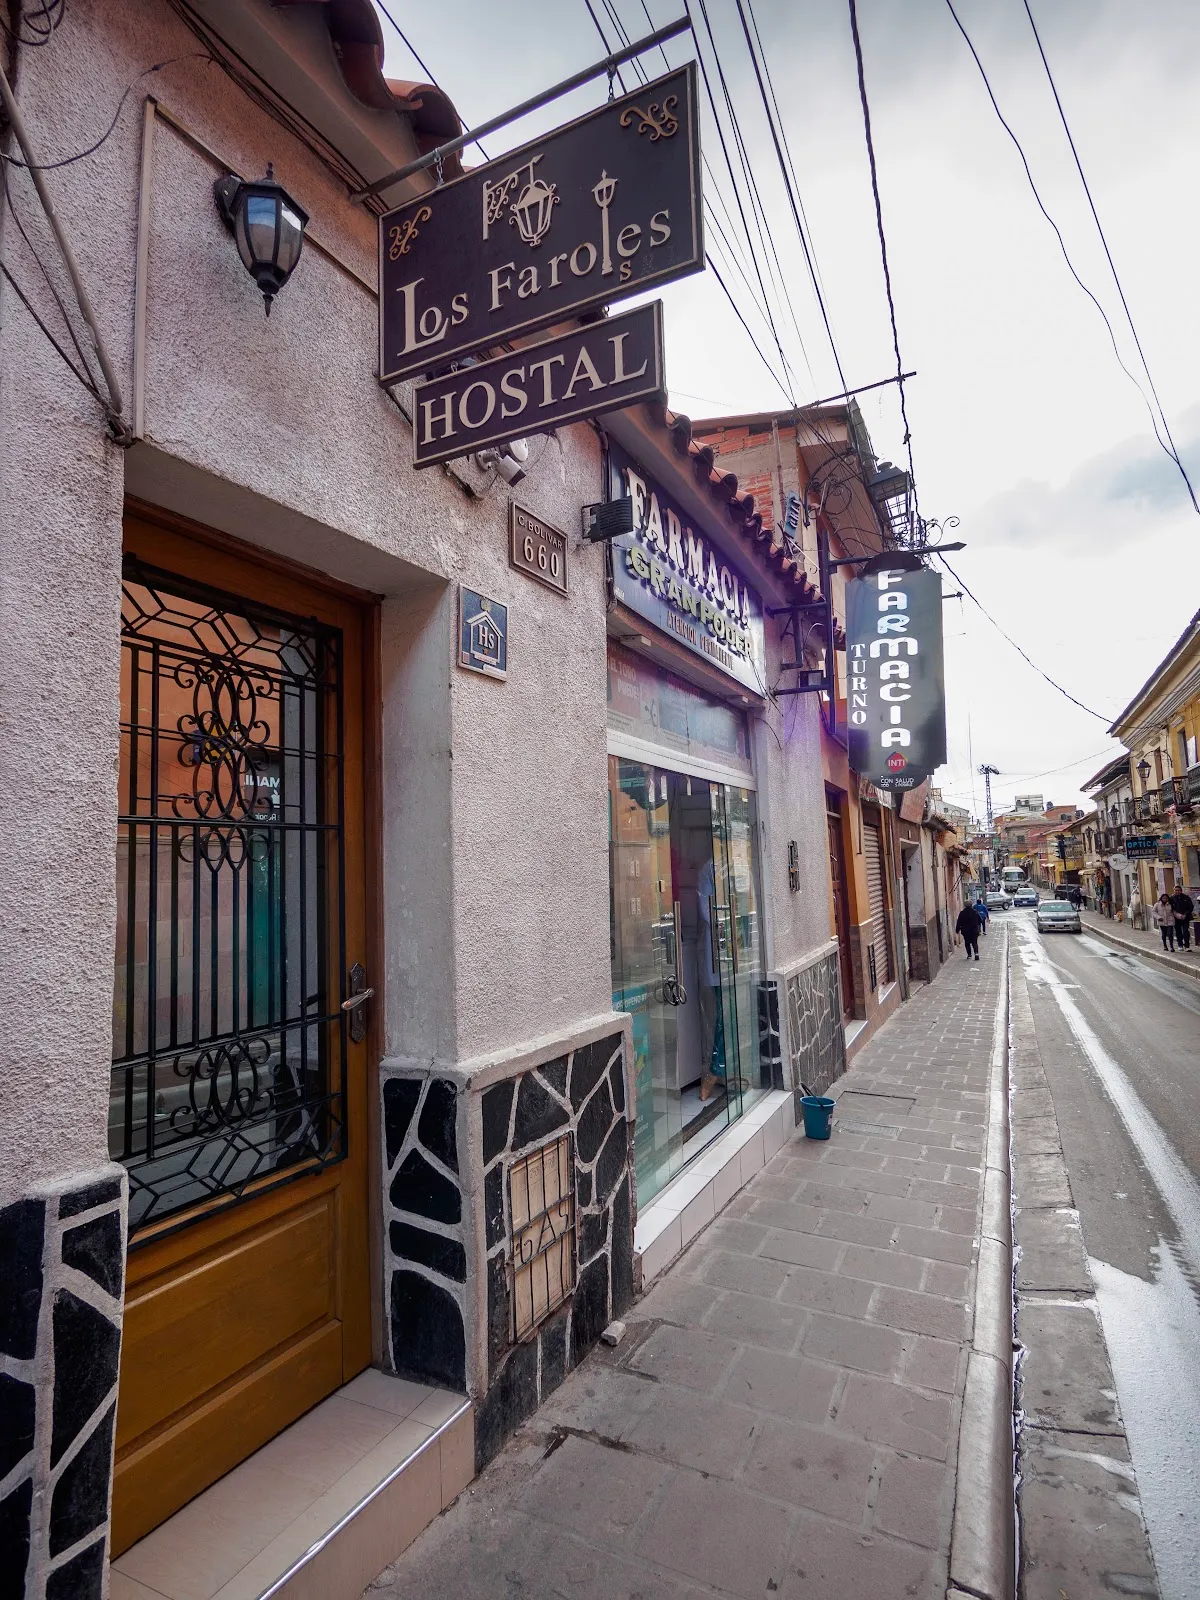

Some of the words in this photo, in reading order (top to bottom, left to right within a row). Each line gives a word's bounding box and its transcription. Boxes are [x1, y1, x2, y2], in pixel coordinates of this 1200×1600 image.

[396, 277, 469, 357] Los
[487, 208, 673, 314] Faroles
[419, 331, 648, 446] HOSTAL
[518, 515, 527, 527] C.
[528, 523, 563, 550] BOLIVAR
[524, 536, 559, 577] 660
[626, 467, 751, 628] FARMACIA
[478, 624, 495, 649] Hs
[629, 546, 698, 618] GRAN
[700, 604, 754, 662] PODER
[851, 643, 868, 726] TURNO
[869, 570, 919, 748] FARMACIA
[889, 759, 906, 767] INTI
[1127, 841, 1158, 849] OPTICA
[516, 1199, 569, 1265] GAS
